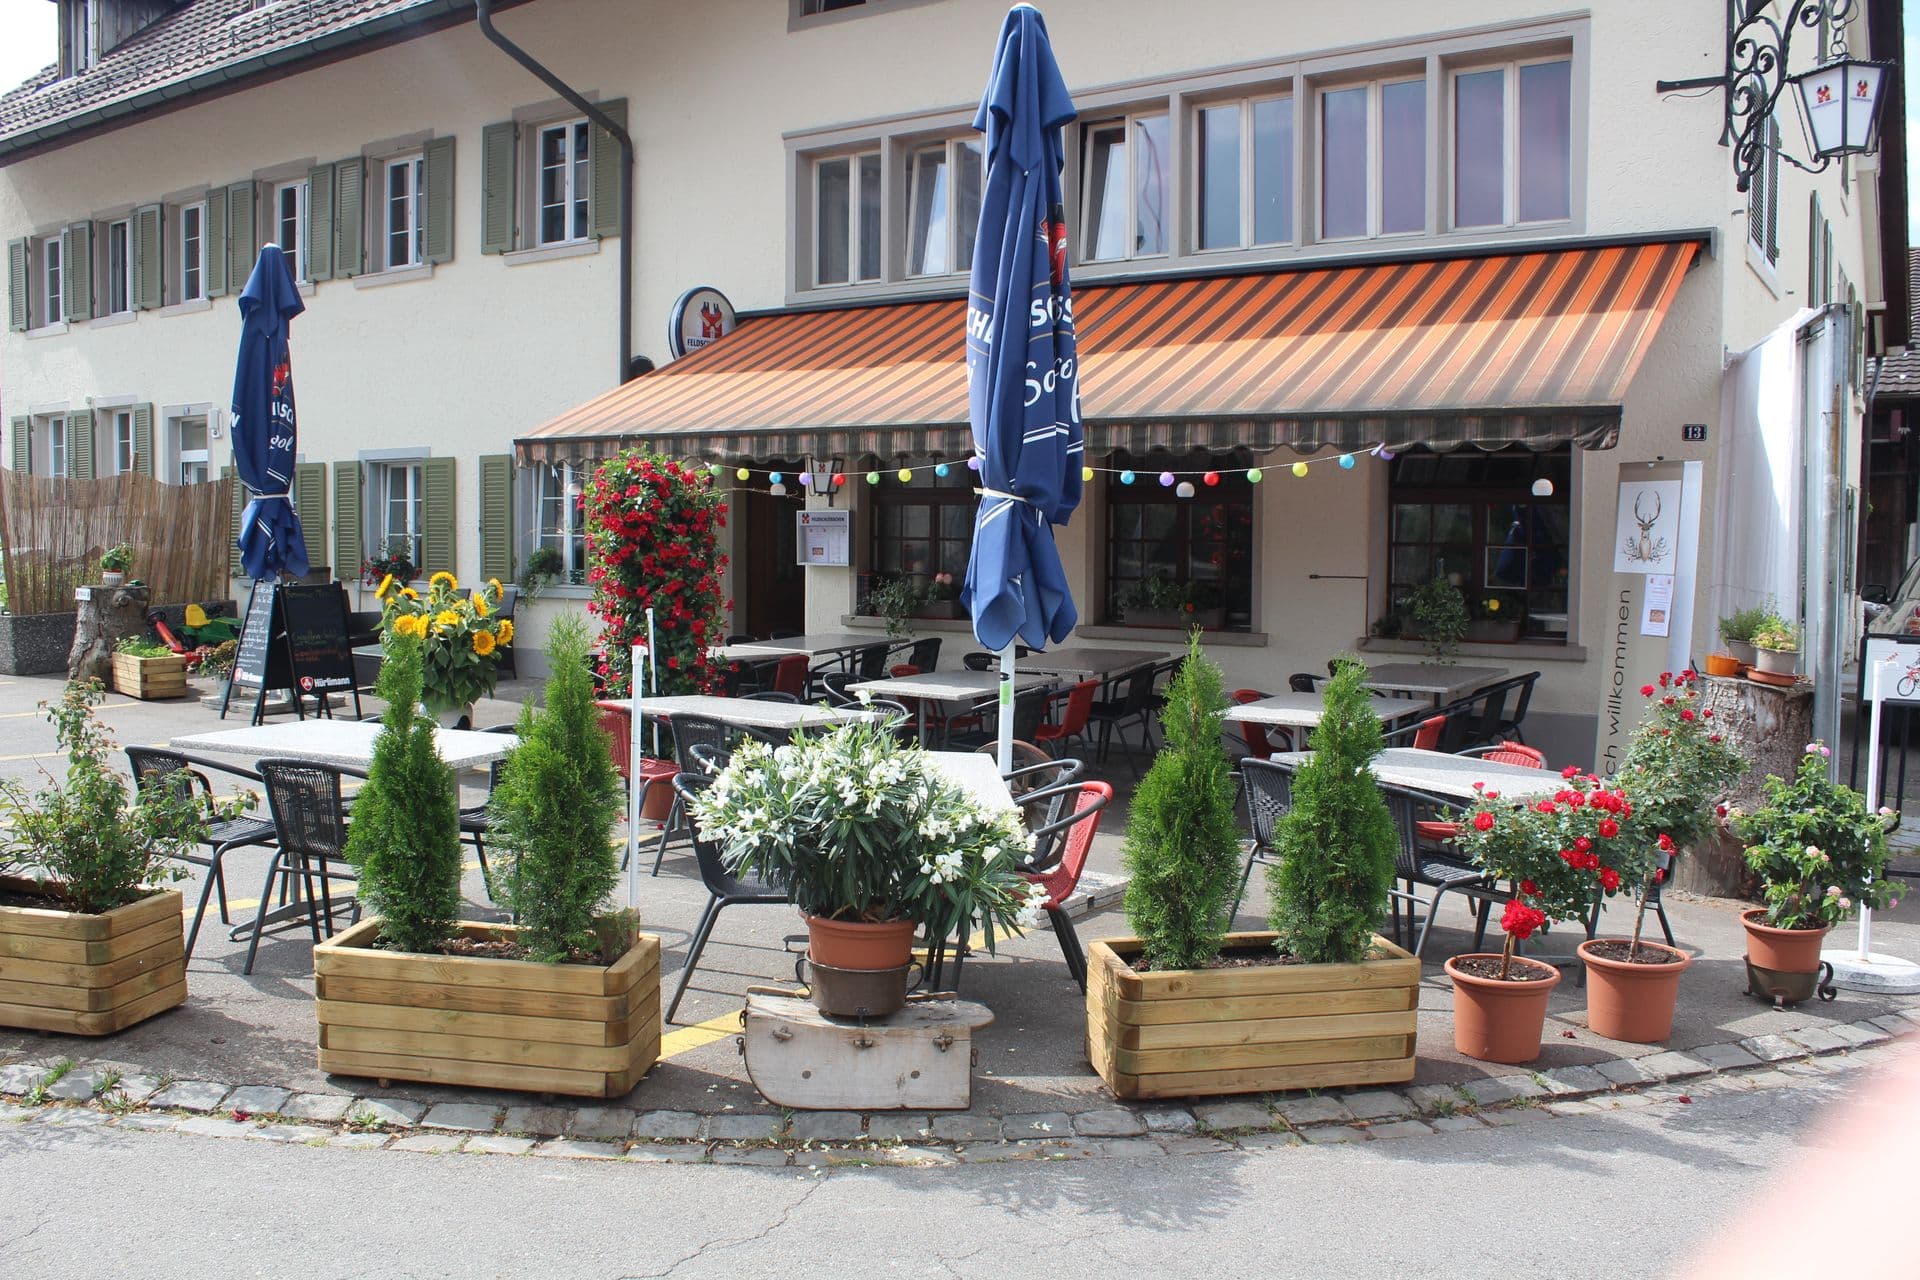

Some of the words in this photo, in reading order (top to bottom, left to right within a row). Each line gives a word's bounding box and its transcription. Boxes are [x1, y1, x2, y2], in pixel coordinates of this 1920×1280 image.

[687, 338, 711, 347] FELDSC
[1687, 426, 1701, 438] 13
[1607, 590, 1631, 736] willkommen
[1602, 745, 1618, 777] ch
